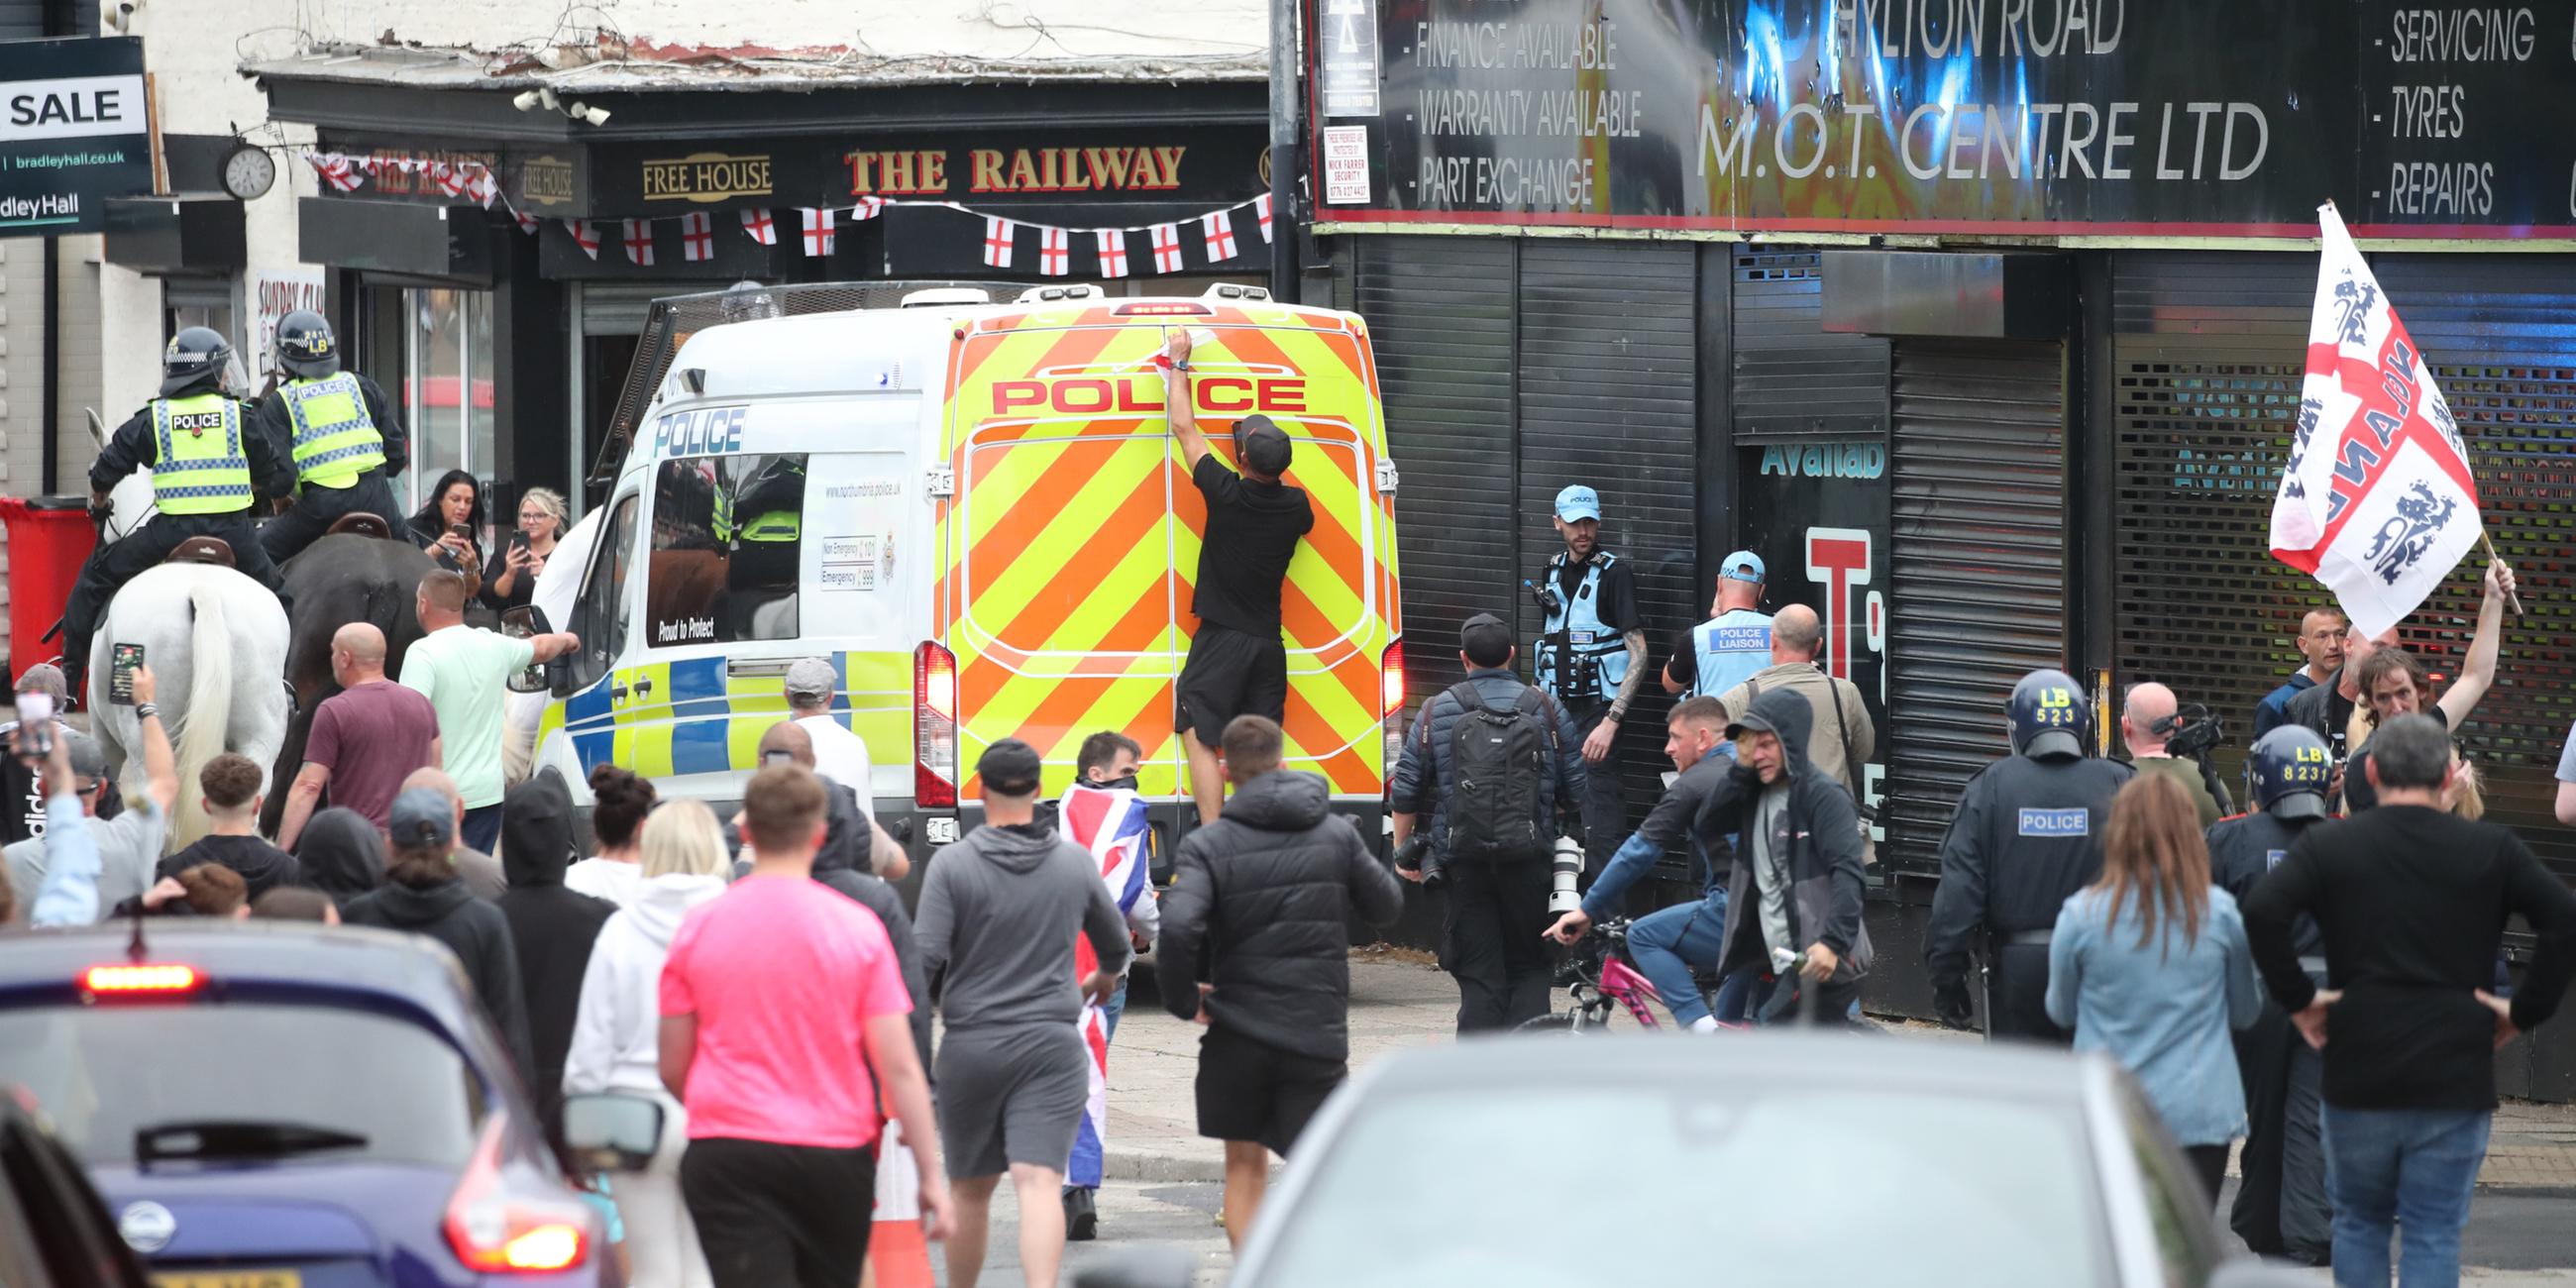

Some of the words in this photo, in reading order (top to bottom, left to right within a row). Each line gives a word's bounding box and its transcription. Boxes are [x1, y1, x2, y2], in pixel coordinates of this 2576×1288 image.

[1417, 21, 1506, 68] FINANCE
[1513, 23, 1617, 70] AVAILABLE
[1999, 0, 2124, 56] ROAD
[2391, 8, 2535, 62] SERVICING
[10, 89, 122, 126] SALE
[1419, 89, 1532, 136] WARRANTY
[1537, 90, 1642, 137] AVAILABLE
[2392, 84, 2465, 138] TYRES
[1697, 103, 1877, 179] M.O.T.
[1900, 102, 2140, 180] CENTRE
[2156, 102, 2269, 180] LTD
[16, 151, 125, 169] bradleyhall.co.uk
[644, 165, 691, 194] FREE
[697, 161, 773, 192] HOUSE
[844, 151, 947, 195] THE
[969, 147, 1186, 193] RAILWAY
[1335, 170, 1361, 181] SECURITY
[1423, 157, 1470, 203] PART
[1476, 158, 1593, 205] EXCHANGE
[2389, 161, 2494, 216] REPAIRS
[259, 279, 298, 317] SUNDAY
[309, 339, 328, 353] LB
[300, 381, 345, 398] POLICE
[992, 377, 1307, 414] POLCE
[173, 413, 221, 429] POLICE
[654, 408, 746, 458] POLICE
[821, 570, 857, 587] Emergency
[863, 569, 873, 586] 999
[658, 619, 679, 642] Proud
[680, 619, 688, 640] to
[689, 617, 714, 639] Protect
[1719, 638, 1765, 649] LIAISON
[1720, 628, 1762, 639] POLICE
[2040, 687, 2071, 708] LB
[2297, 746, 2322, 762] LB
[2022, 814, 2085, 829] POLICE
